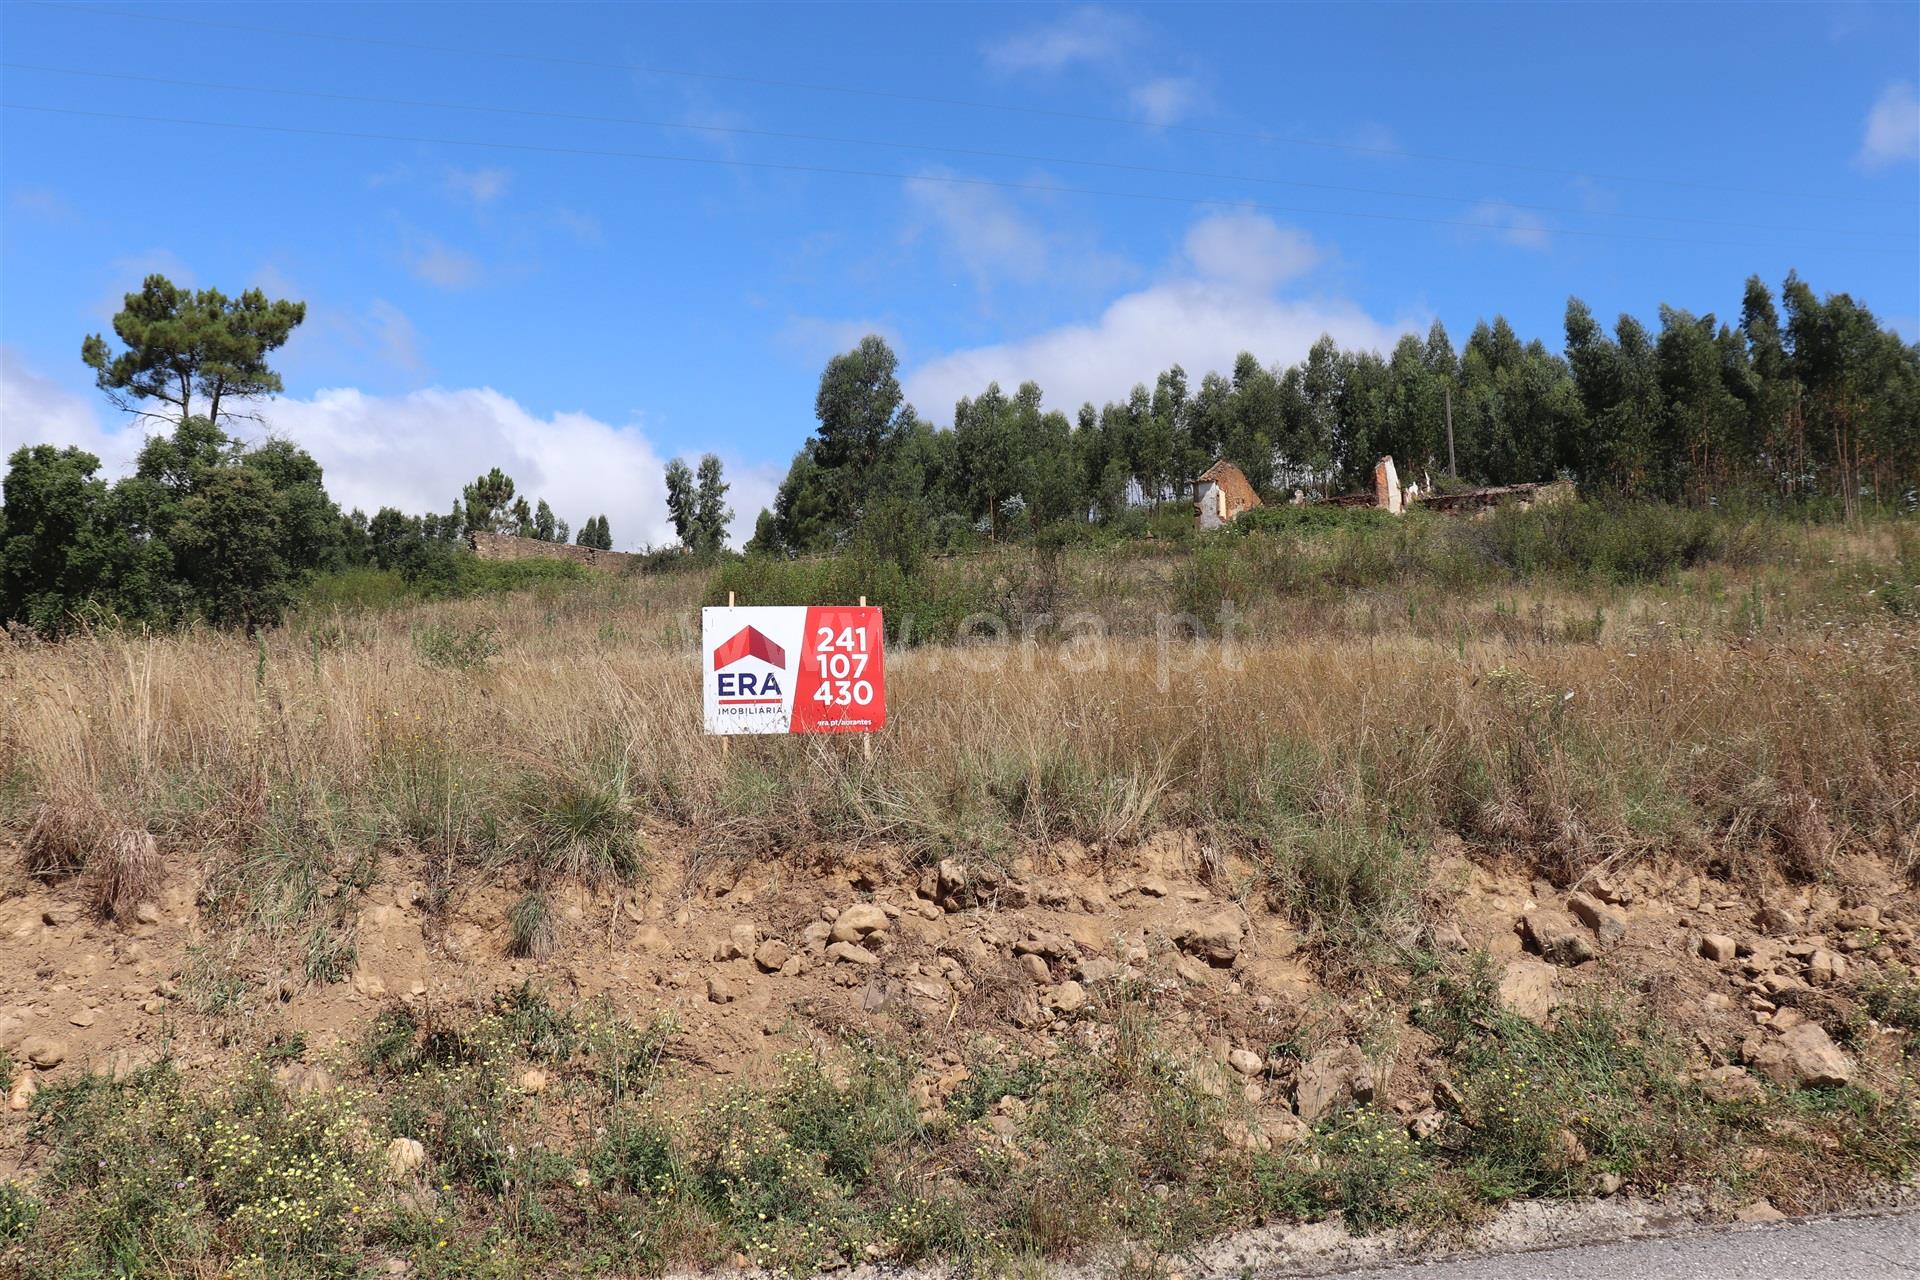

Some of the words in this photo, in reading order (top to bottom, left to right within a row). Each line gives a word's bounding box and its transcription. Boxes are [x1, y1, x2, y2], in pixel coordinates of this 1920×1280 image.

[817, 627, 866, 652] 241
[817, 654, 868, 679] 107
[718, 673, 782, 696] ERA
[814, 681, 873, 705] 430
